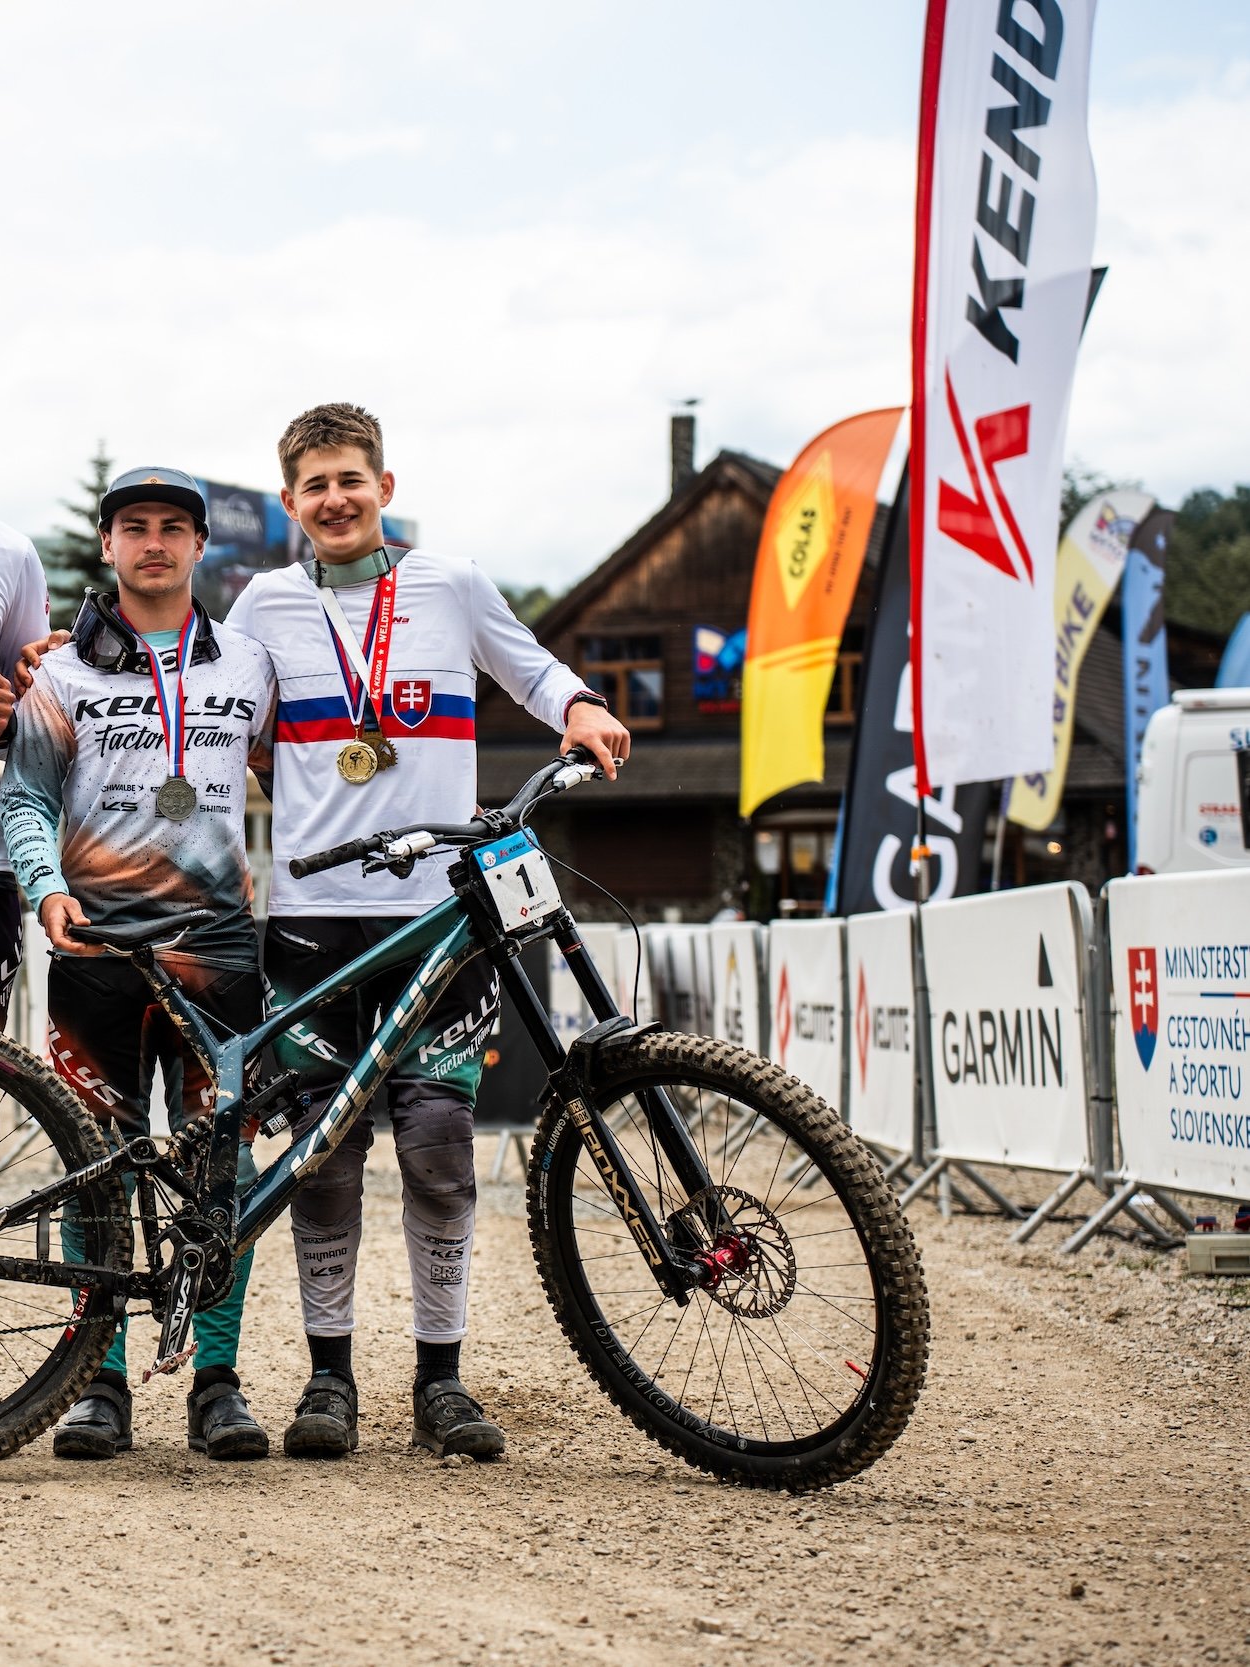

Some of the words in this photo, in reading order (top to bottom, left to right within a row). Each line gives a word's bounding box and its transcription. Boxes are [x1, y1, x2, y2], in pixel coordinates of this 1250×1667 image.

[378, 596, 391, 644] WELDTITE
[373, 659, 384, 688] KENDA
[94, 723, 167, 757] Factor
[101, 783, 136, 793] CHWALBE
[102, 801, 139, 812] KS
[509, 841, 526, 854] KENDA
[515, 863, 535, 898] 1
[1165, 944, 1250, 981] MINISTERST
[430, 1045, 475, 1081] Factory
[941, 1006, 1065, 1089] GARMIN
[1170, 1062, 1179, 1094] A
[1181, 1054, 1242, 1099] ŠPORTU
[548, 1118, 567, 1153] GRAVITY
[542, 1151, 554, 1171] PRO
[580, 1124, 663, 1269] BOXXER
[303, 1247, 349, 1263] SHIMANO
[310, 1263, 344, 1278] KS
[430, 1264, 464, 1280] PRO
[75, 1289, 90, 1314] 541
